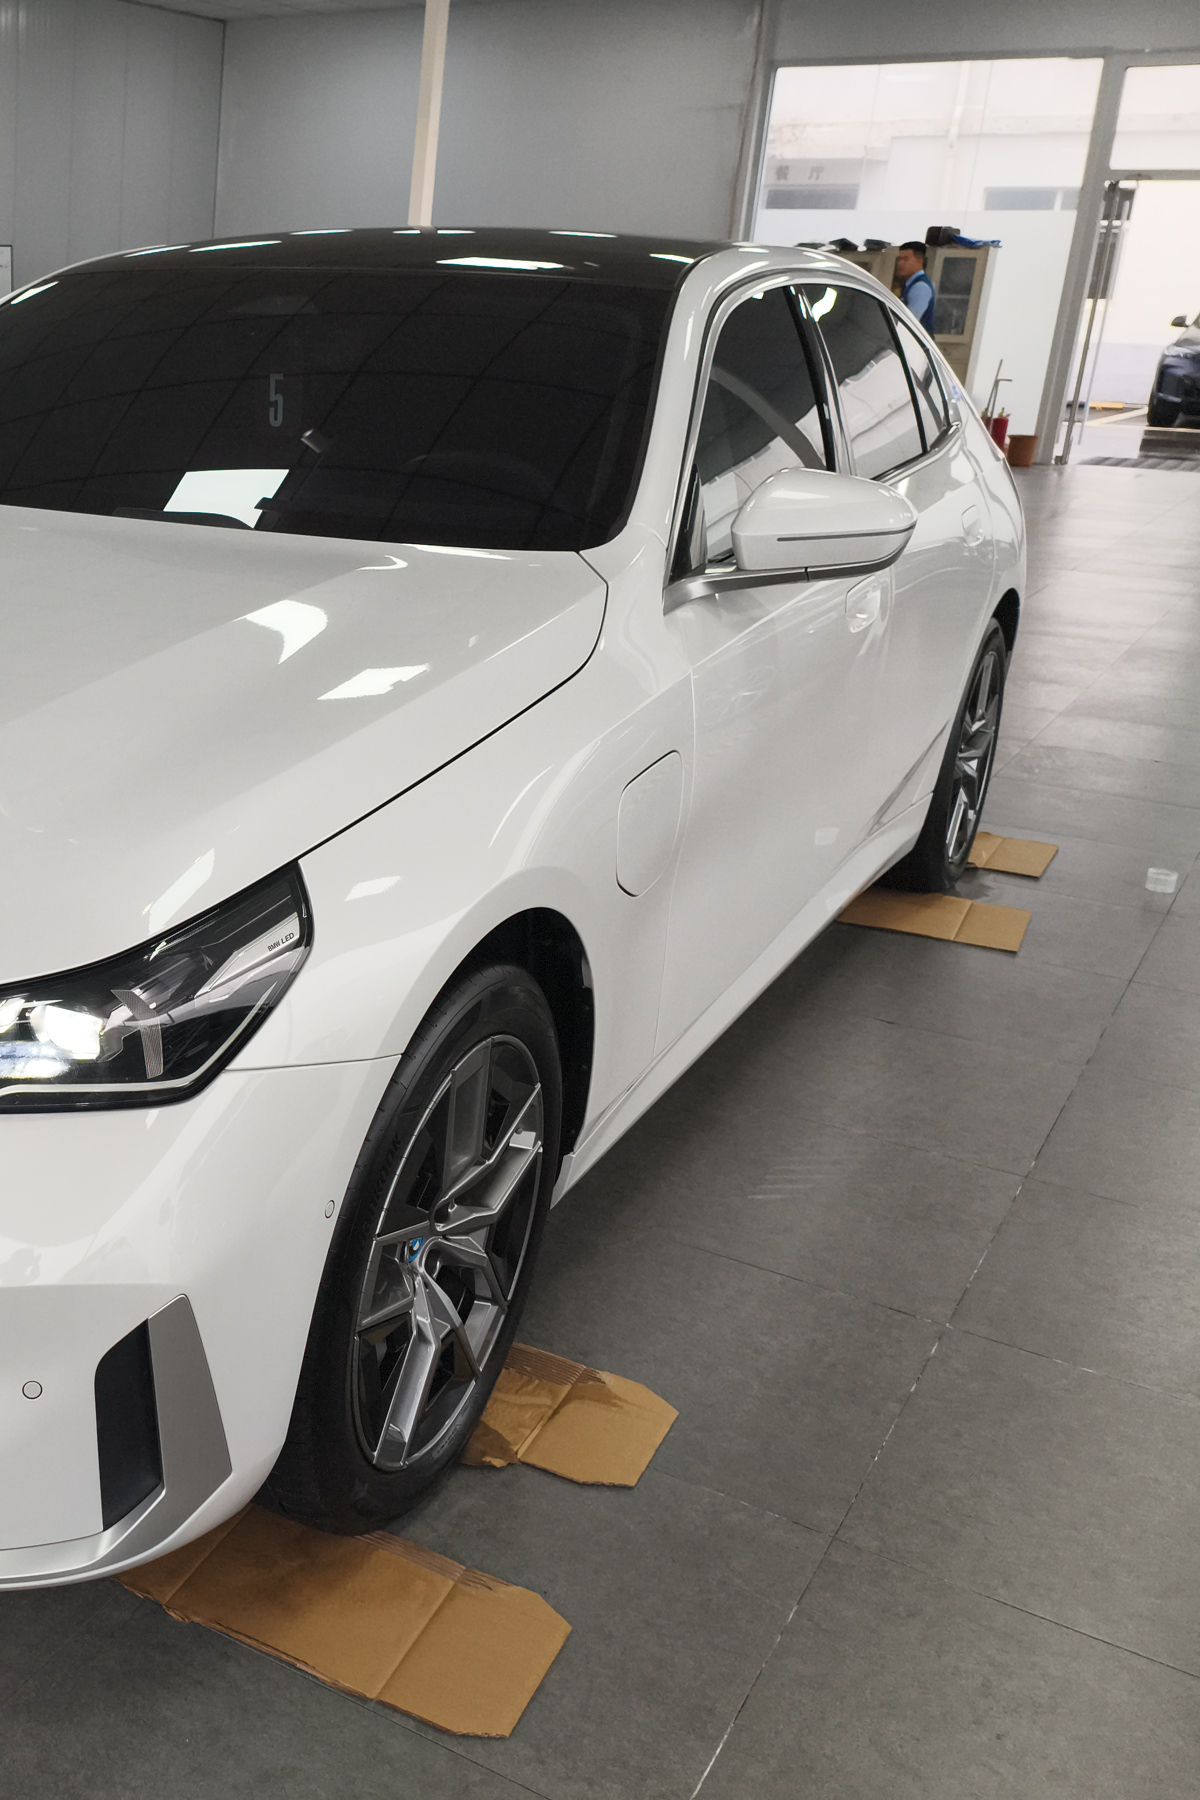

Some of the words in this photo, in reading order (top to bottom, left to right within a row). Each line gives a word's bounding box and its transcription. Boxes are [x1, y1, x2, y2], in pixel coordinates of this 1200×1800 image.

[268, 373, 284, 428] 5
[267, 940, 281, 952] BMW
[281, 932, 295, 944] LED
